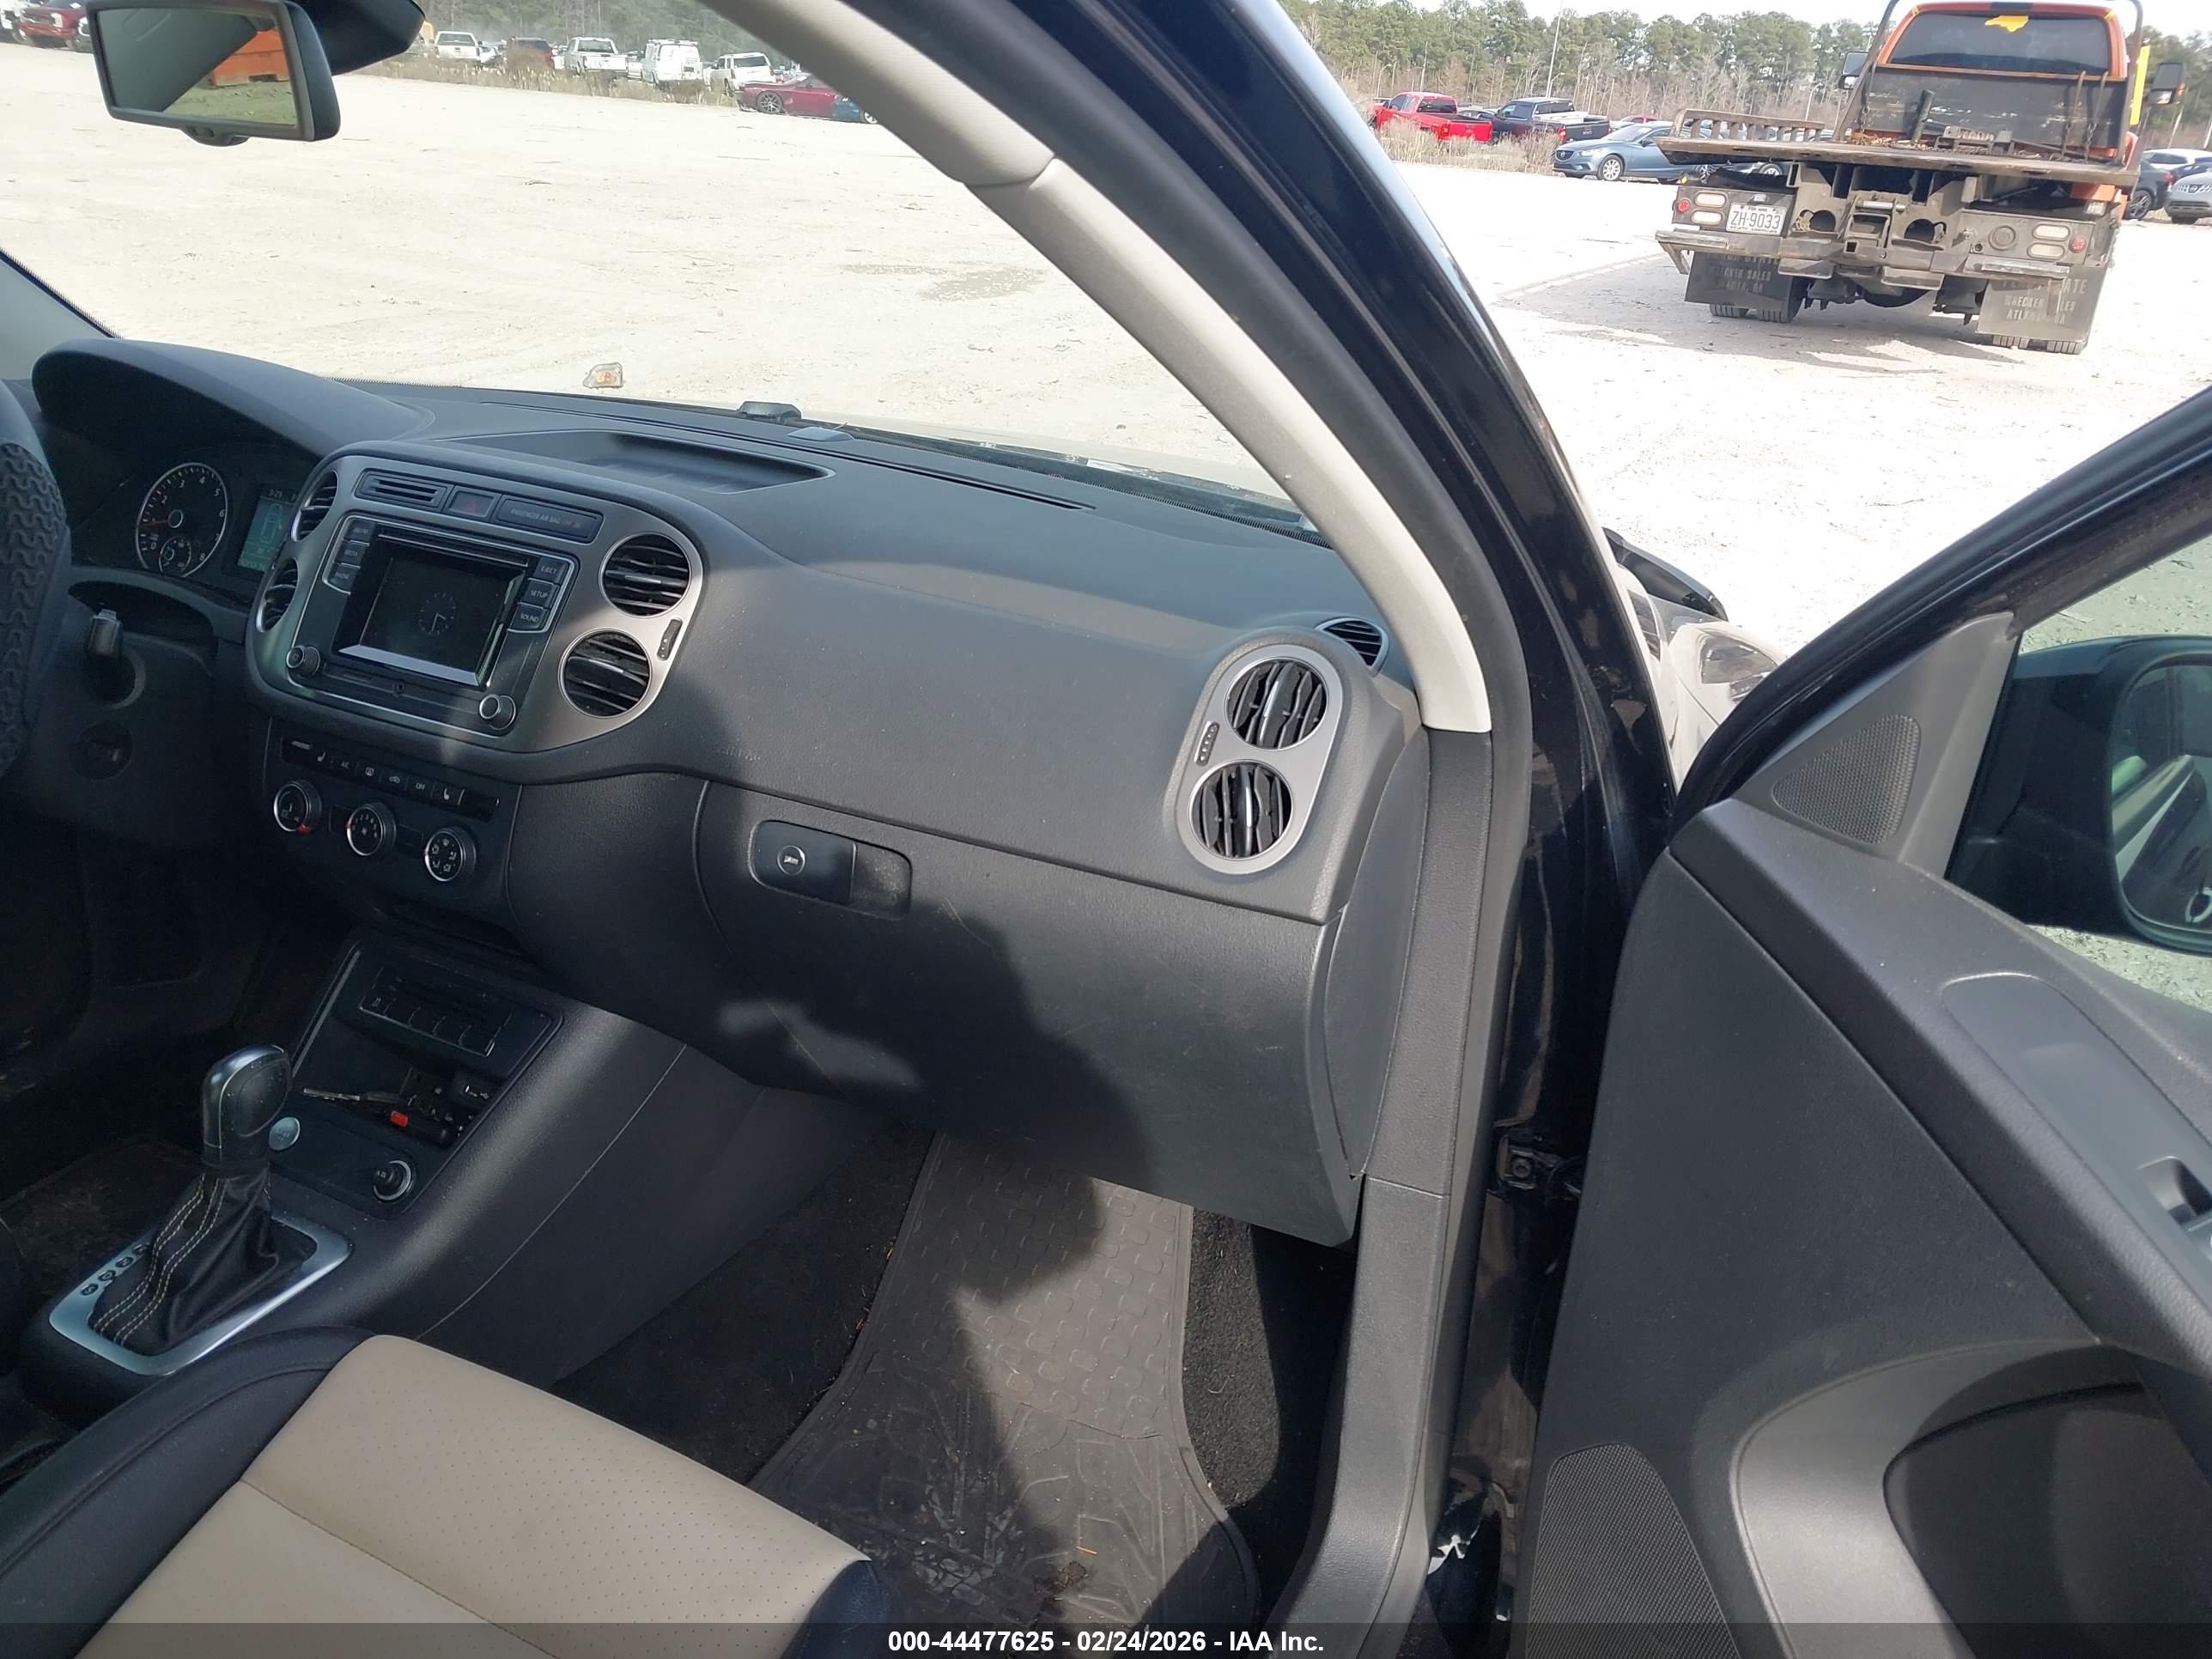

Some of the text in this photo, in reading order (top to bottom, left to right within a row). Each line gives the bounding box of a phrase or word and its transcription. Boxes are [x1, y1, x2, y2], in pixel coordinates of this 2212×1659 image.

[1730, 210, 1781, 229] ZH-9033
[213, 488, 221, 496] 5
[219, 508, 225, 518] 6
[198, 552, 206, 562] 8
